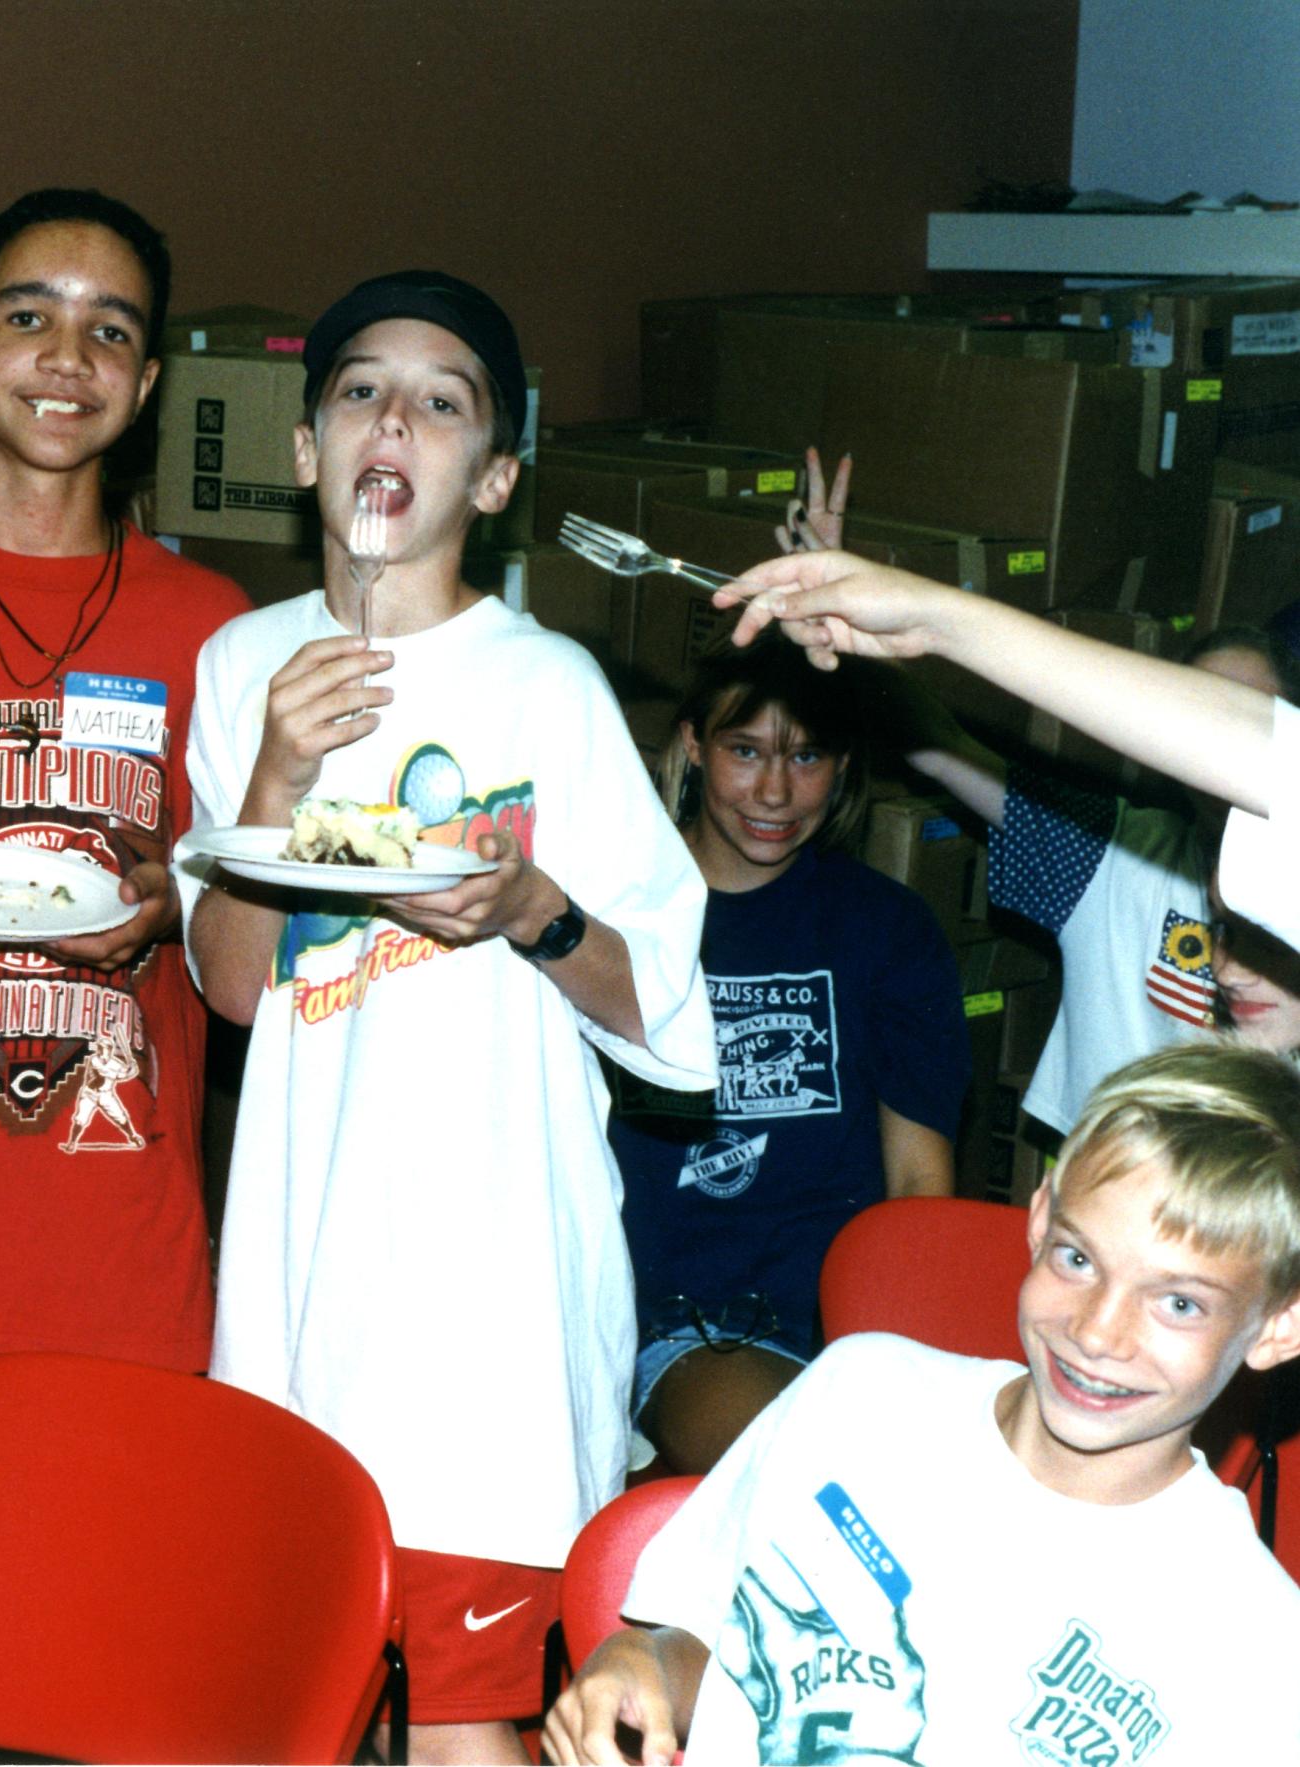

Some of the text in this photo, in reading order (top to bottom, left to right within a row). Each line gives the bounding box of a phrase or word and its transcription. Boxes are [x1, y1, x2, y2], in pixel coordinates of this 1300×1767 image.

[224, 488, 252, 504] THE
[254, 489, 305, 508] LIBRA
[88, 677, 148, 695] HELLO
[73, 708, 165, 742] NATHEN
[293, 951, 373, 1025] Famy
[707, 983, 819, 1005] RAUSS & CO.
[716, 1033, 775, 1060] THING.
[840, 1505, 895, 1575] HELLO
[790, 1646, 896, 1704] RCKS
[1037, 1627, 1163, 1763] Donatos
